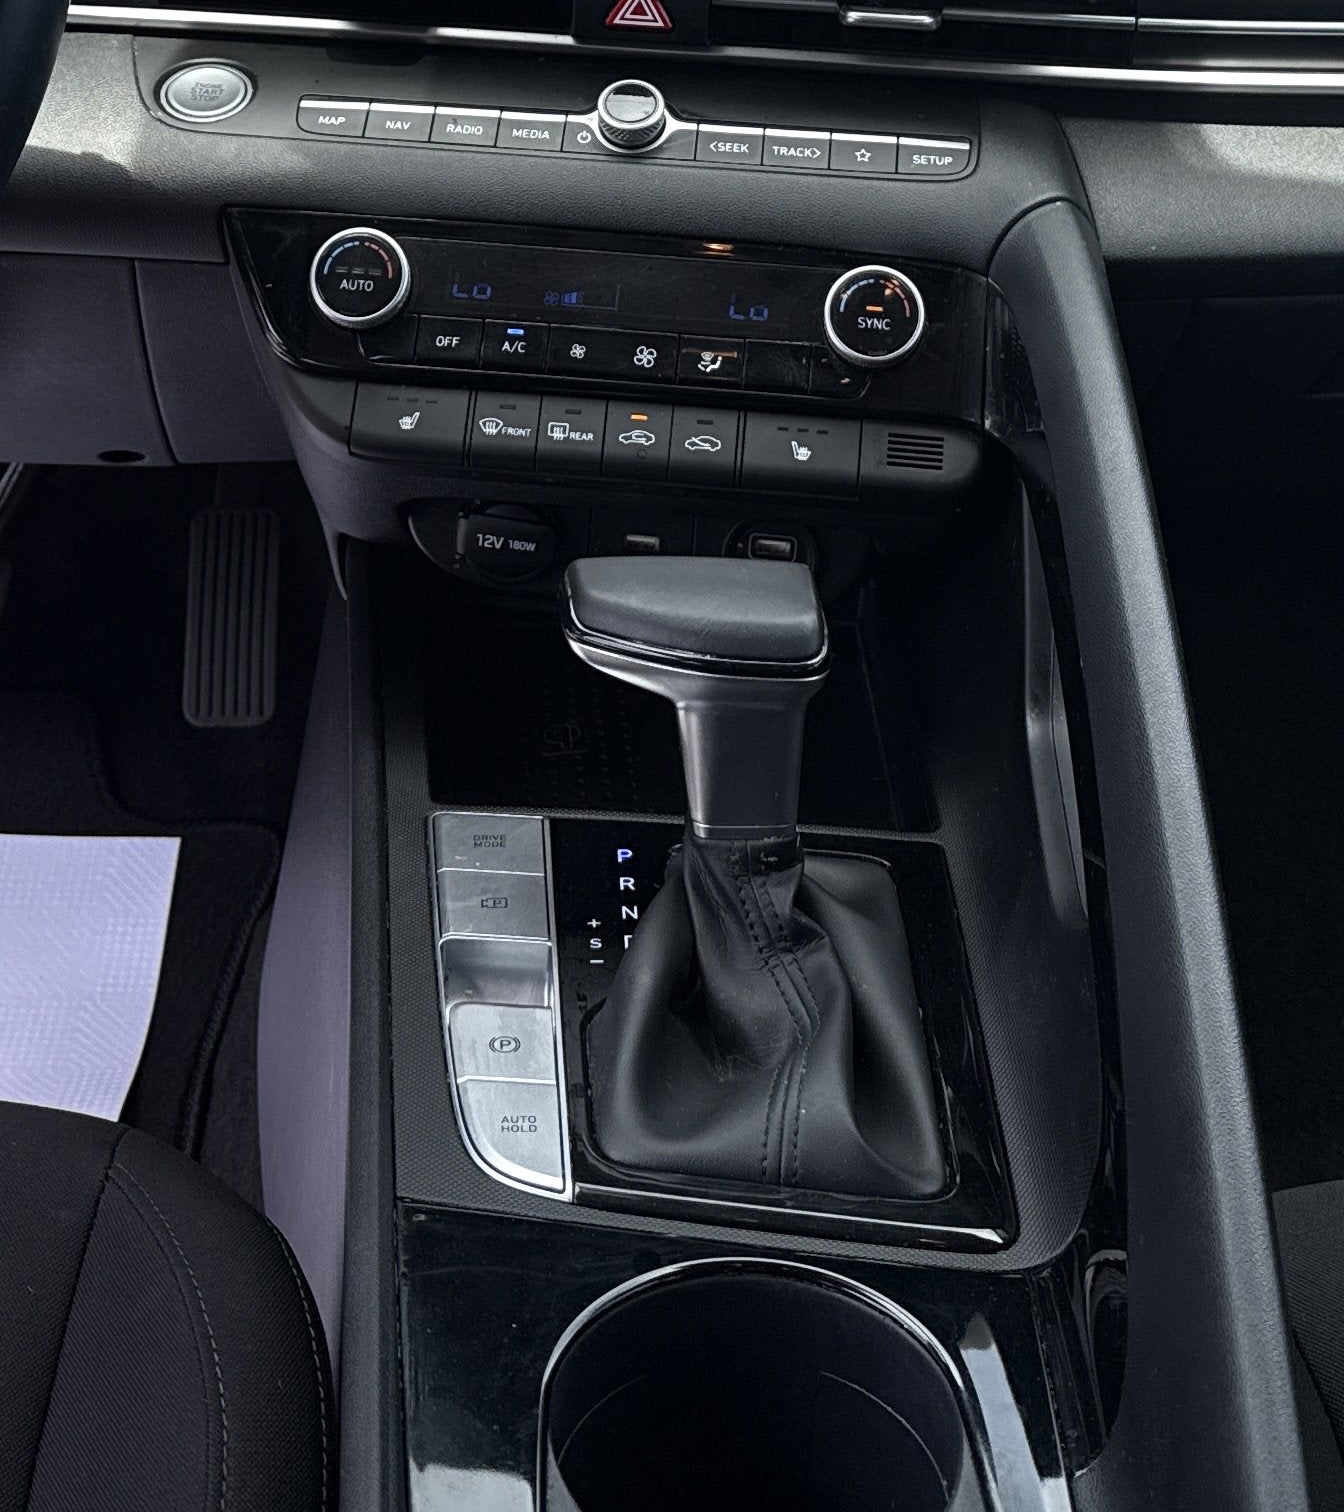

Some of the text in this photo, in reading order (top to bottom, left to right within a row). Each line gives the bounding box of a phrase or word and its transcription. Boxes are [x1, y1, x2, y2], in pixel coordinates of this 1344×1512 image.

[190, 87, 225, 96] START
[318, 115, 346, 126] MAP
[385, 120, 411, 131] NAV
[446, 123, 484, 136] RADIO
[512, 128, 550, 140] MEDIA
[912, 154, 954, 166] SETUP
[340, 279, 374, 292] AUTO
[858, 317, 892, 331] SYNC
[435, 335, 461, 348] OFF
[501, 341, 526, 354] A/C
[501, 427, 532, 438] FRONT
[569, 432, 594, 442] REAR
[476, 534, 536, 552] 12V 180W
[617, 848, 633, 863] P
[619, 876, 635, 891] R
[621, 905, 638, 919] N
[589, 938, 602, 949] S
[501, 1115, 537, 1124] AUTO
[501, 1124, 538, 1133] HOLD
